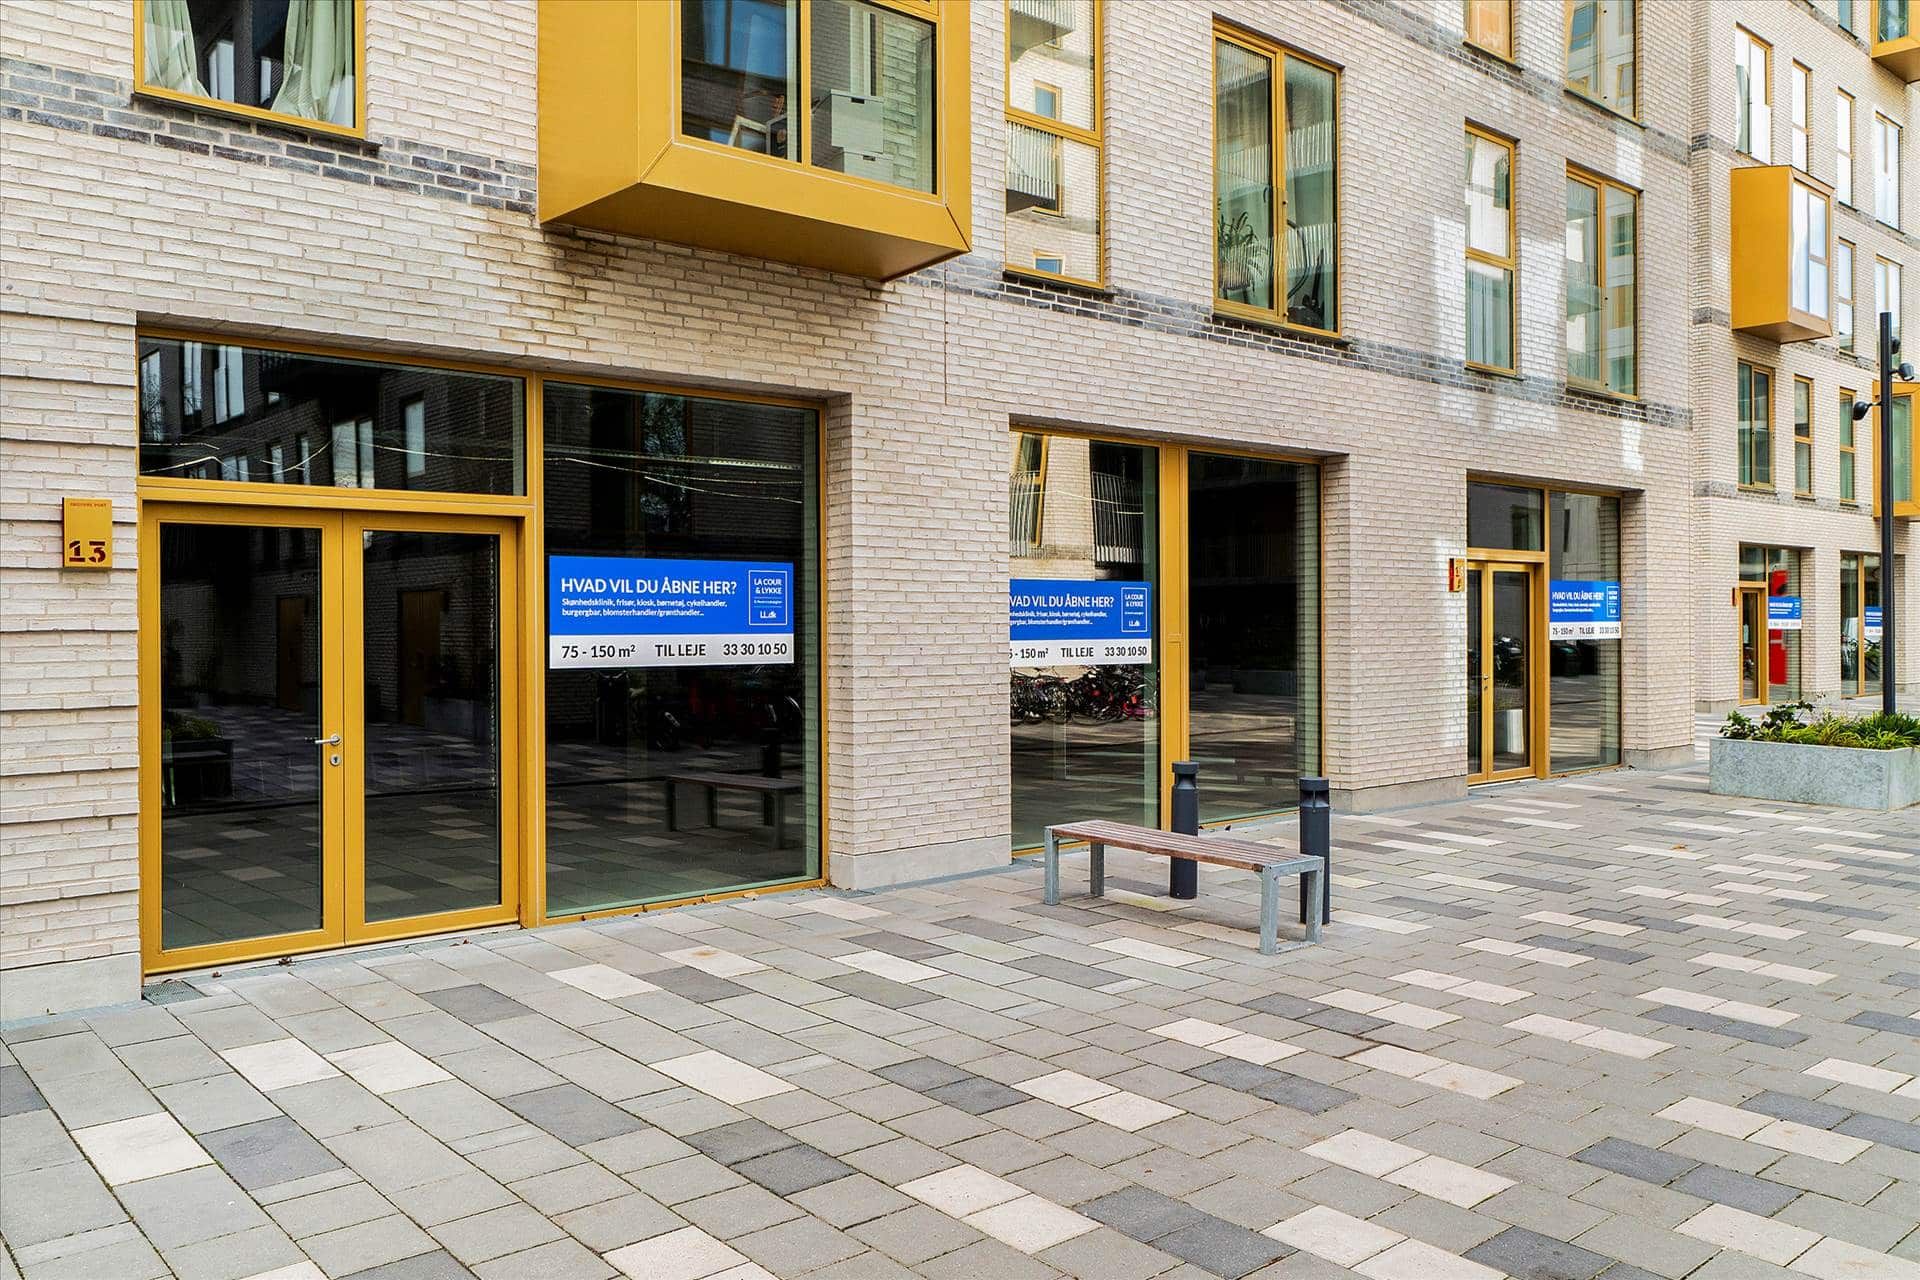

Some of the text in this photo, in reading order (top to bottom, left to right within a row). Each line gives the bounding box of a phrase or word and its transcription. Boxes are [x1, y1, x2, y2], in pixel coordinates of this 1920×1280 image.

[69, 540, 106, 563] 13
[561, 576, 737, 595] HVAD VIL DU ÅBNE HER?
[763, 578, 782, 586] COUR
[562, 598, 616, 607] Skønhedsklinik,
[637, 599, 656, 607] kiosk,
[1009, 595, 1030, 607] VAD
[1031, 595, 1047, 607] VIL
[1048, 595, 1063, 607] DU
[1064, 593, 1090, 607] ÅBNE
[1092, 596, 1114, 608] HER?
[1552, 591, 1565, 600] HVAD
[561, 645, 579, 658] 75
[591, 645, 615, 658] 150
[655, 644, 675, 657] TIL
[678, 644, 706, 657] LEJE
[723, 643, 738, 656] 33
[740, 643, 755, 656] 30
[758, 643, 771, 655] 10
[773, 642, 787, 655] 50
[1008, 648, 1013, 659] 5
[1020, 648, 1036, 659] 150
[1061, 648, 1074, 657] TIL
[1075, 647, 1094, 657] LEJE
[1105, 647, 1115, 657] 33
[1116, 647, 1126, 656] 30
[1127, 647, 1137, 656] 10
[1137, 646, 1147, 656] 50
